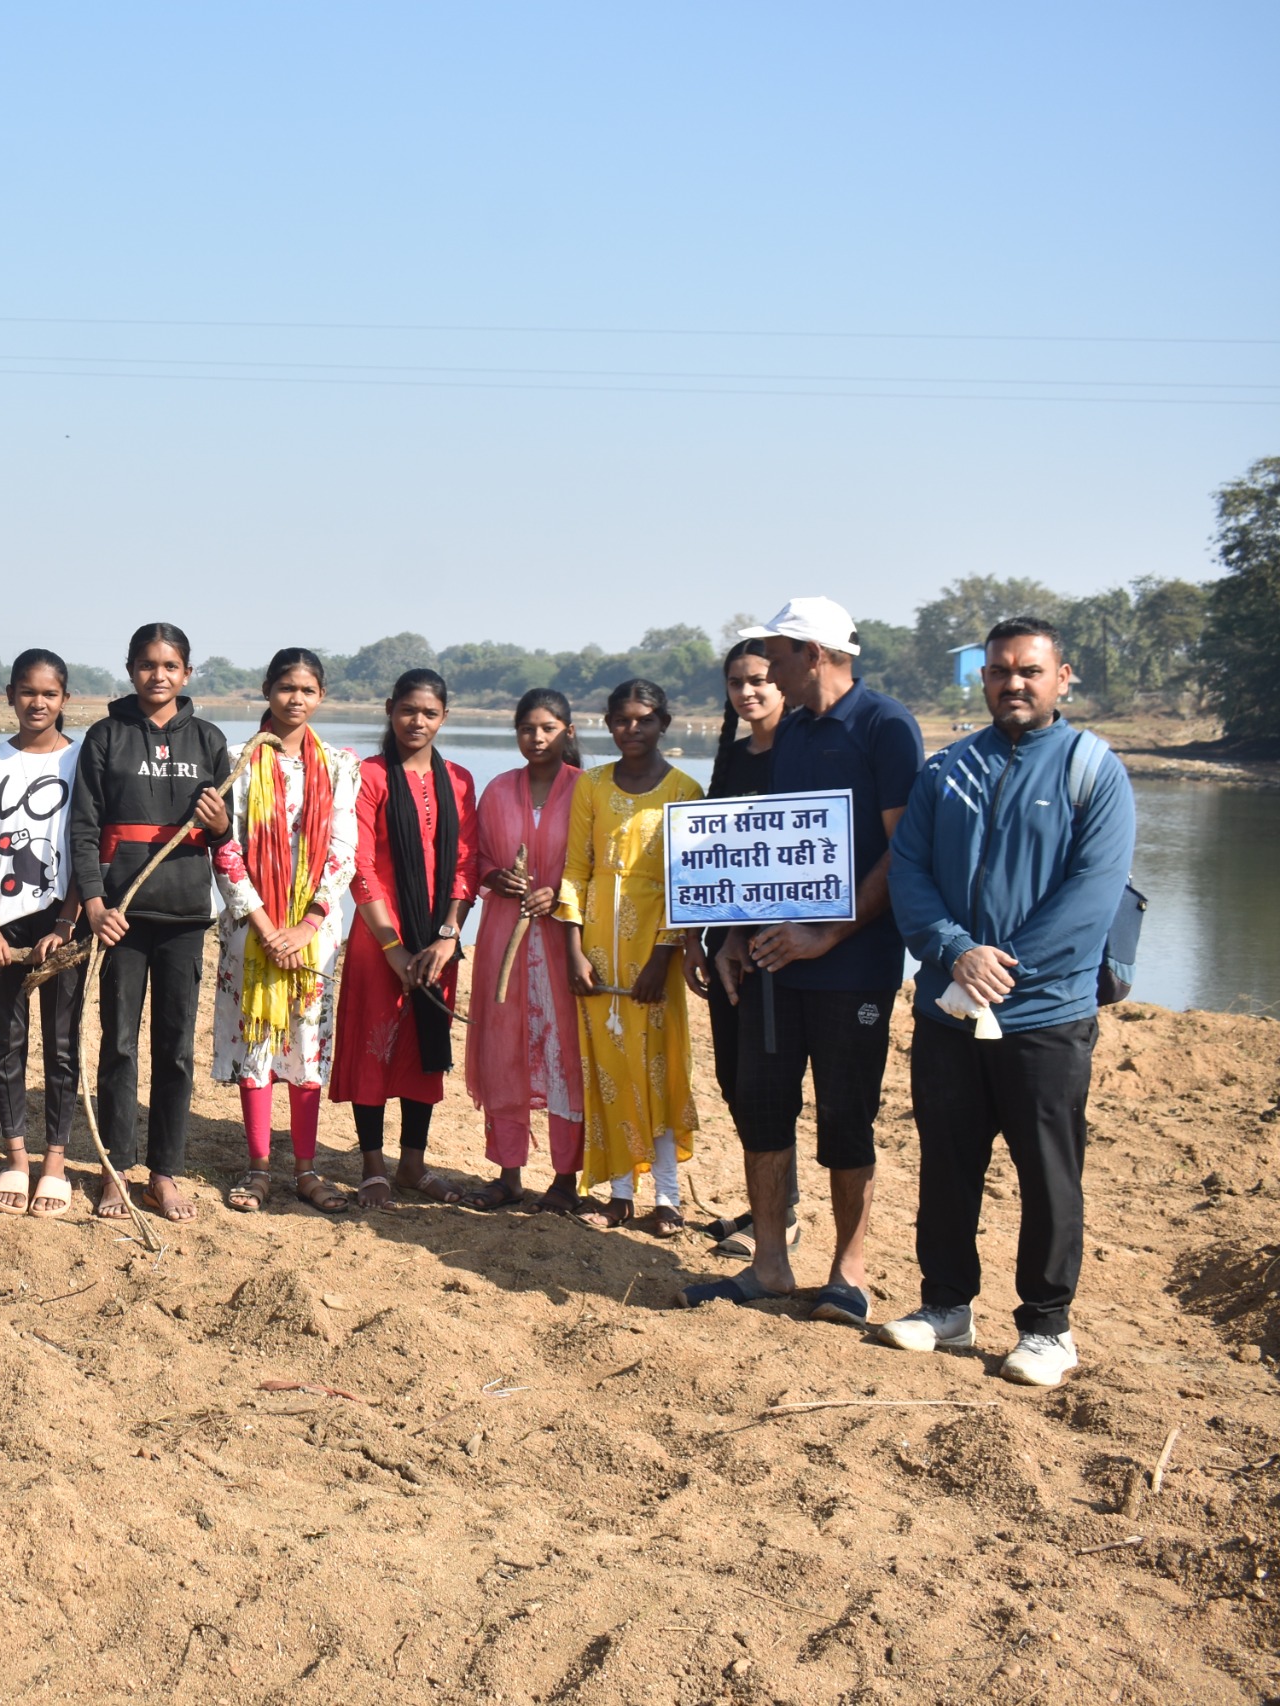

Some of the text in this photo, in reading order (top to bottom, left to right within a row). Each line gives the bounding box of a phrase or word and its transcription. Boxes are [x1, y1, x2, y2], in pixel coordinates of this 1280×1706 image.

[137, 760, 199, 779] AMRI
[687, 805, 829, 834] जल संचय जन
[681, 837, 838, 869] भागीदारी यही है
[678, 874, 842, 905] हमारी जवाबदारी
